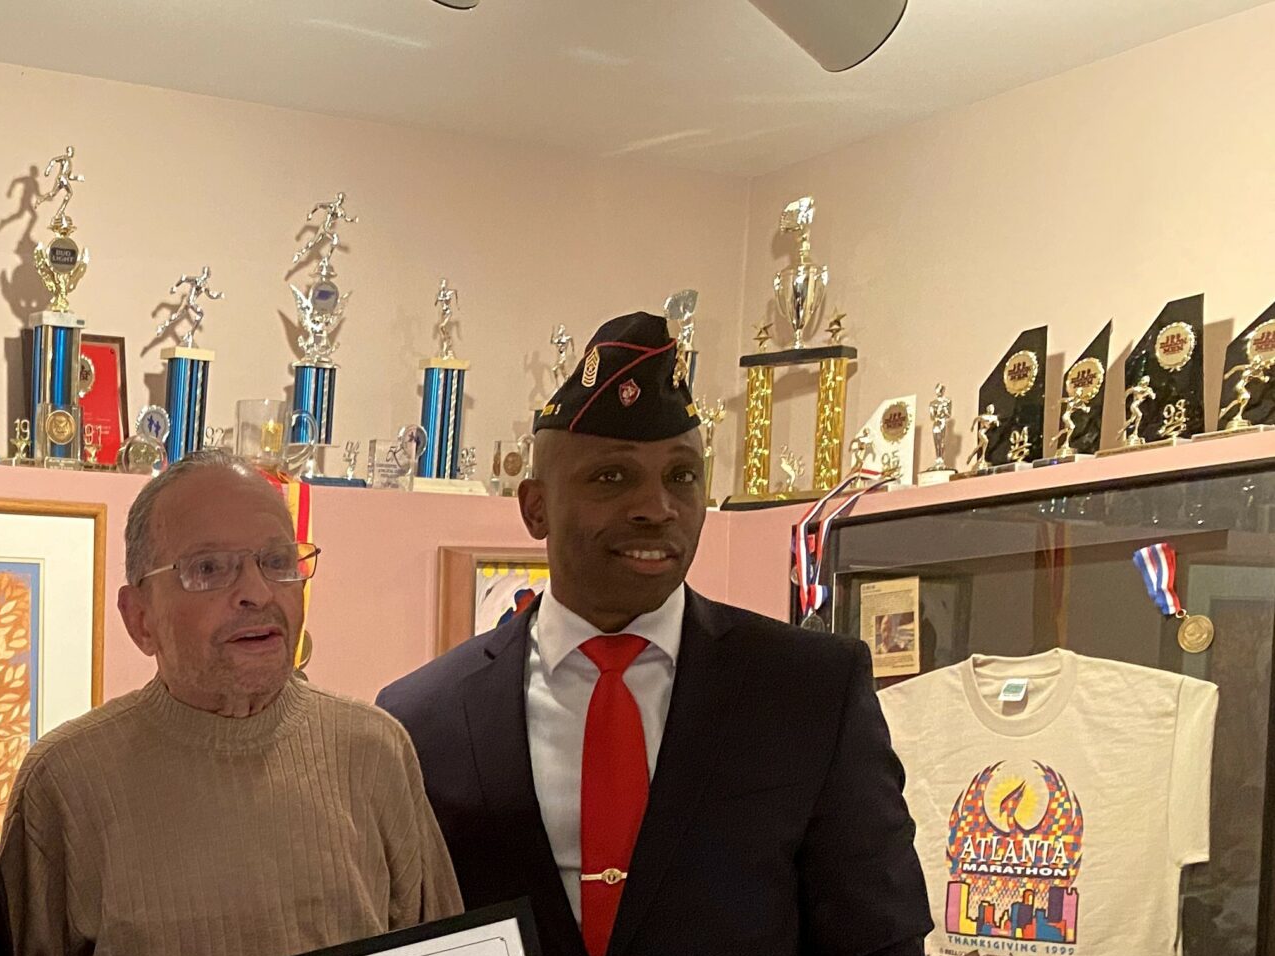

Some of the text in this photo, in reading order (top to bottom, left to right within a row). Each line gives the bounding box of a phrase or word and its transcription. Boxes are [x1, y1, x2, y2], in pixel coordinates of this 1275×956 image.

[1162, 345, 1185, 355] MEN
[13, 418, 30, 441] 19
[84, 423, 103, 446] 91
[960, 835, 1069, 866] ATLANTA
[962, 863, 1068, 877] MARATHON
[947, 935, 1075, 955] THANKSGIVING 1999
